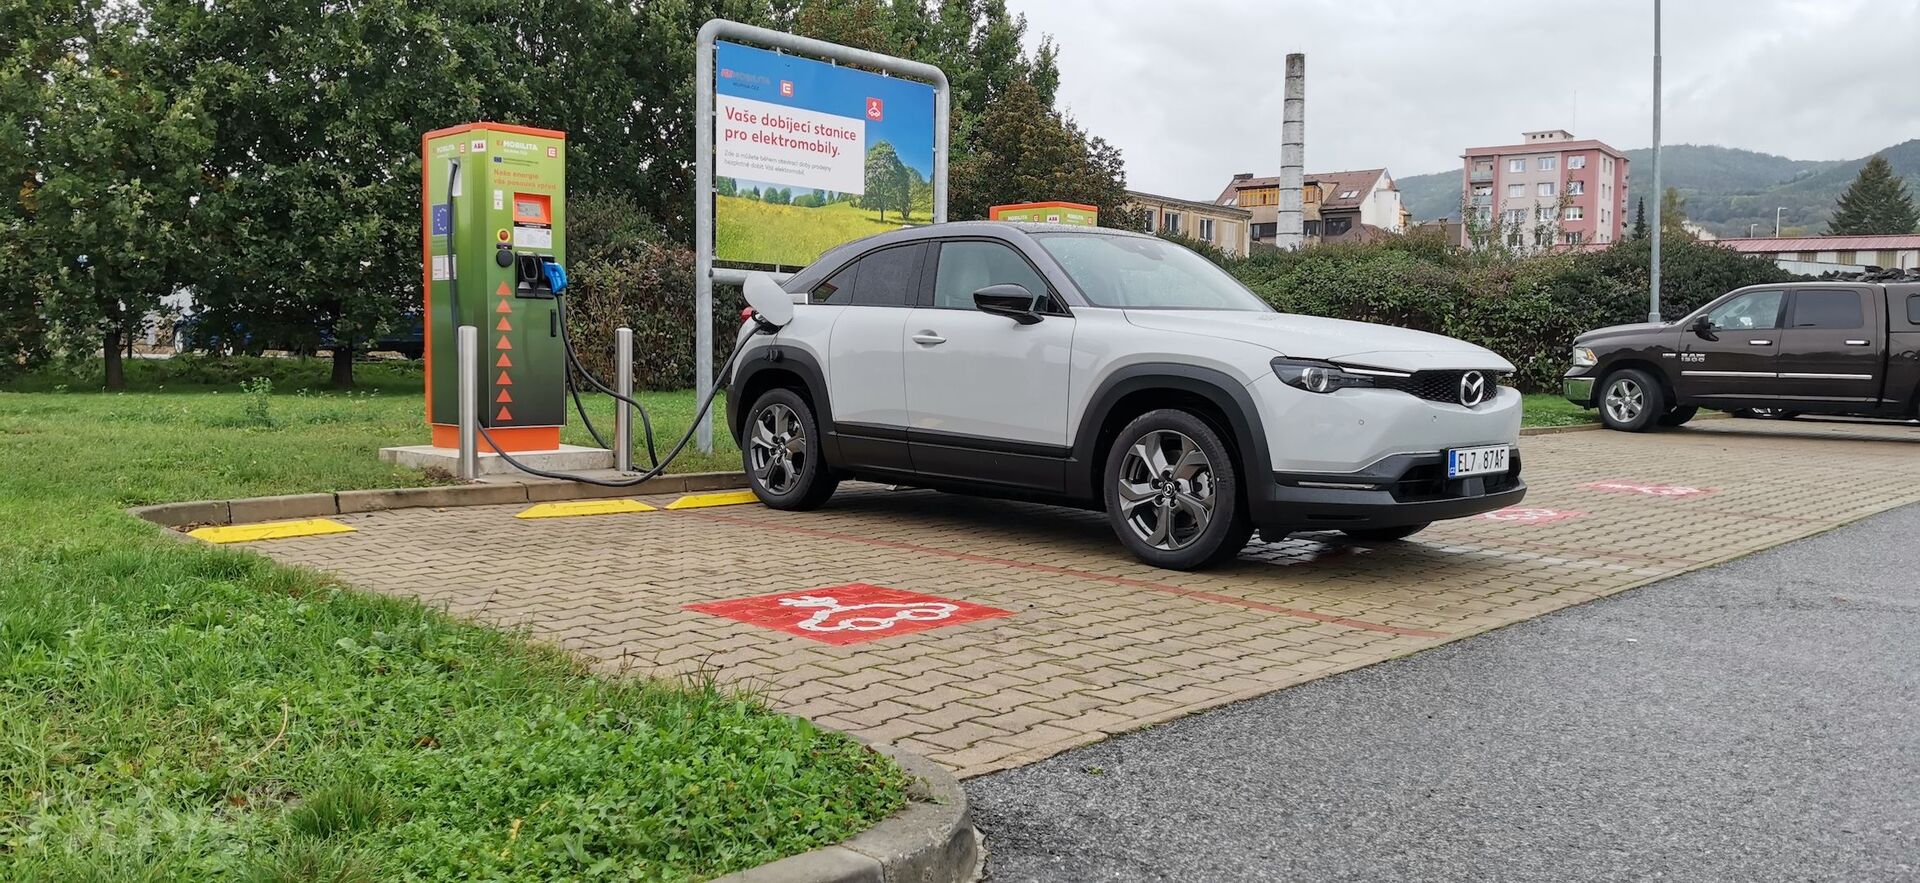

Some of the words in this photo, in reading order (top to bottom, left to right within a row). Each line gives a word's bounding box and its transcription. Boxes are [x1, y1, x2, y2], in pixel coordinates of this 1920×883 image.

[725, 106, 757, 124] Vaše
[761, 113, 811, 133] dobíjecí
[814, 124, 857, 141] stanice
[725, 128, 747, 142] pro
[752, 130, 840, 158] elektromobily.
[1458, 452, 1476, 472] EL7
[1483, 449, 1505, 469] 87AF
